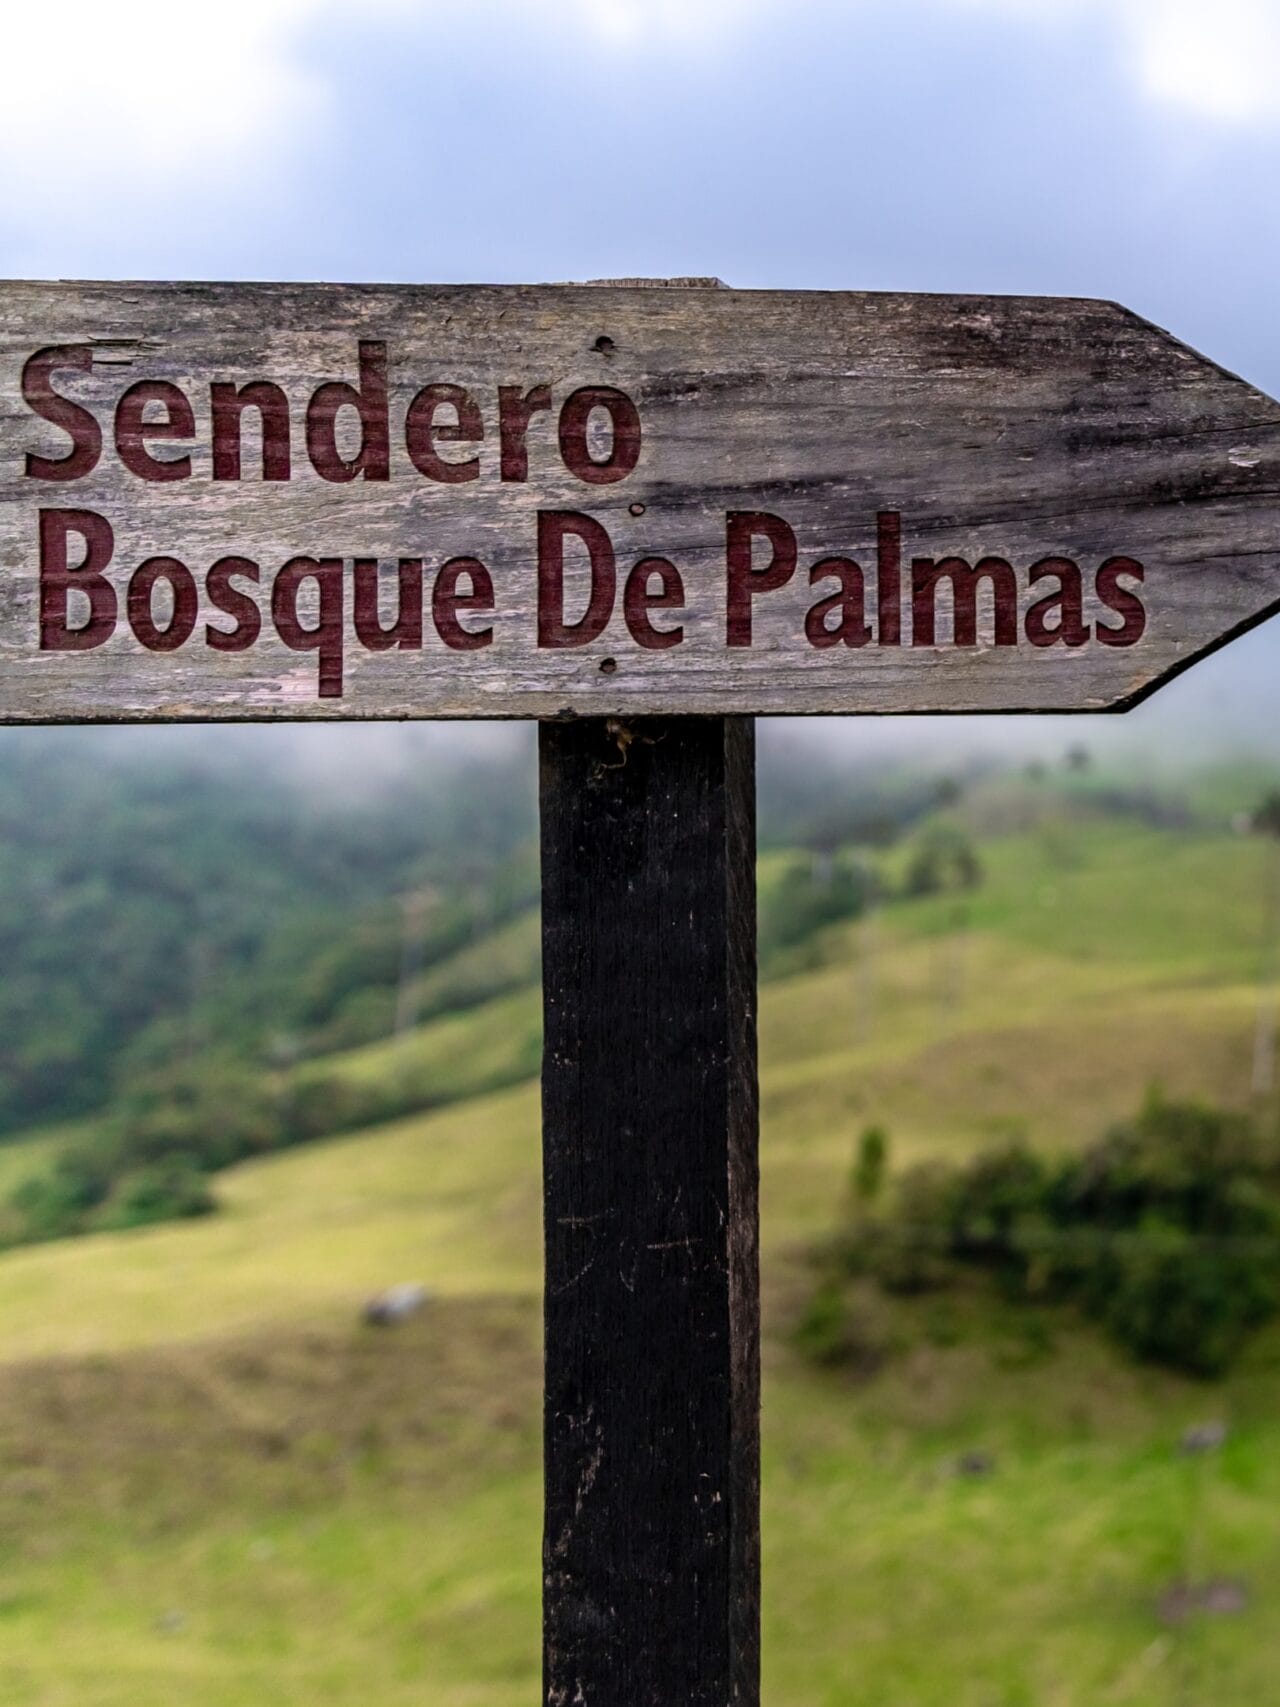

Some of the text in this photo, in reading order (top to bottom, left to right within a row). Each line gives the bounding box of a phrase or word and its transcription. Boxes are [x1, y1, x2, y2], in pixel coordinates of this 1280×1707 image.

[22, 339, 641, 484] Sendero
[38, 508, 1147, 697] Bosque De Palmas
